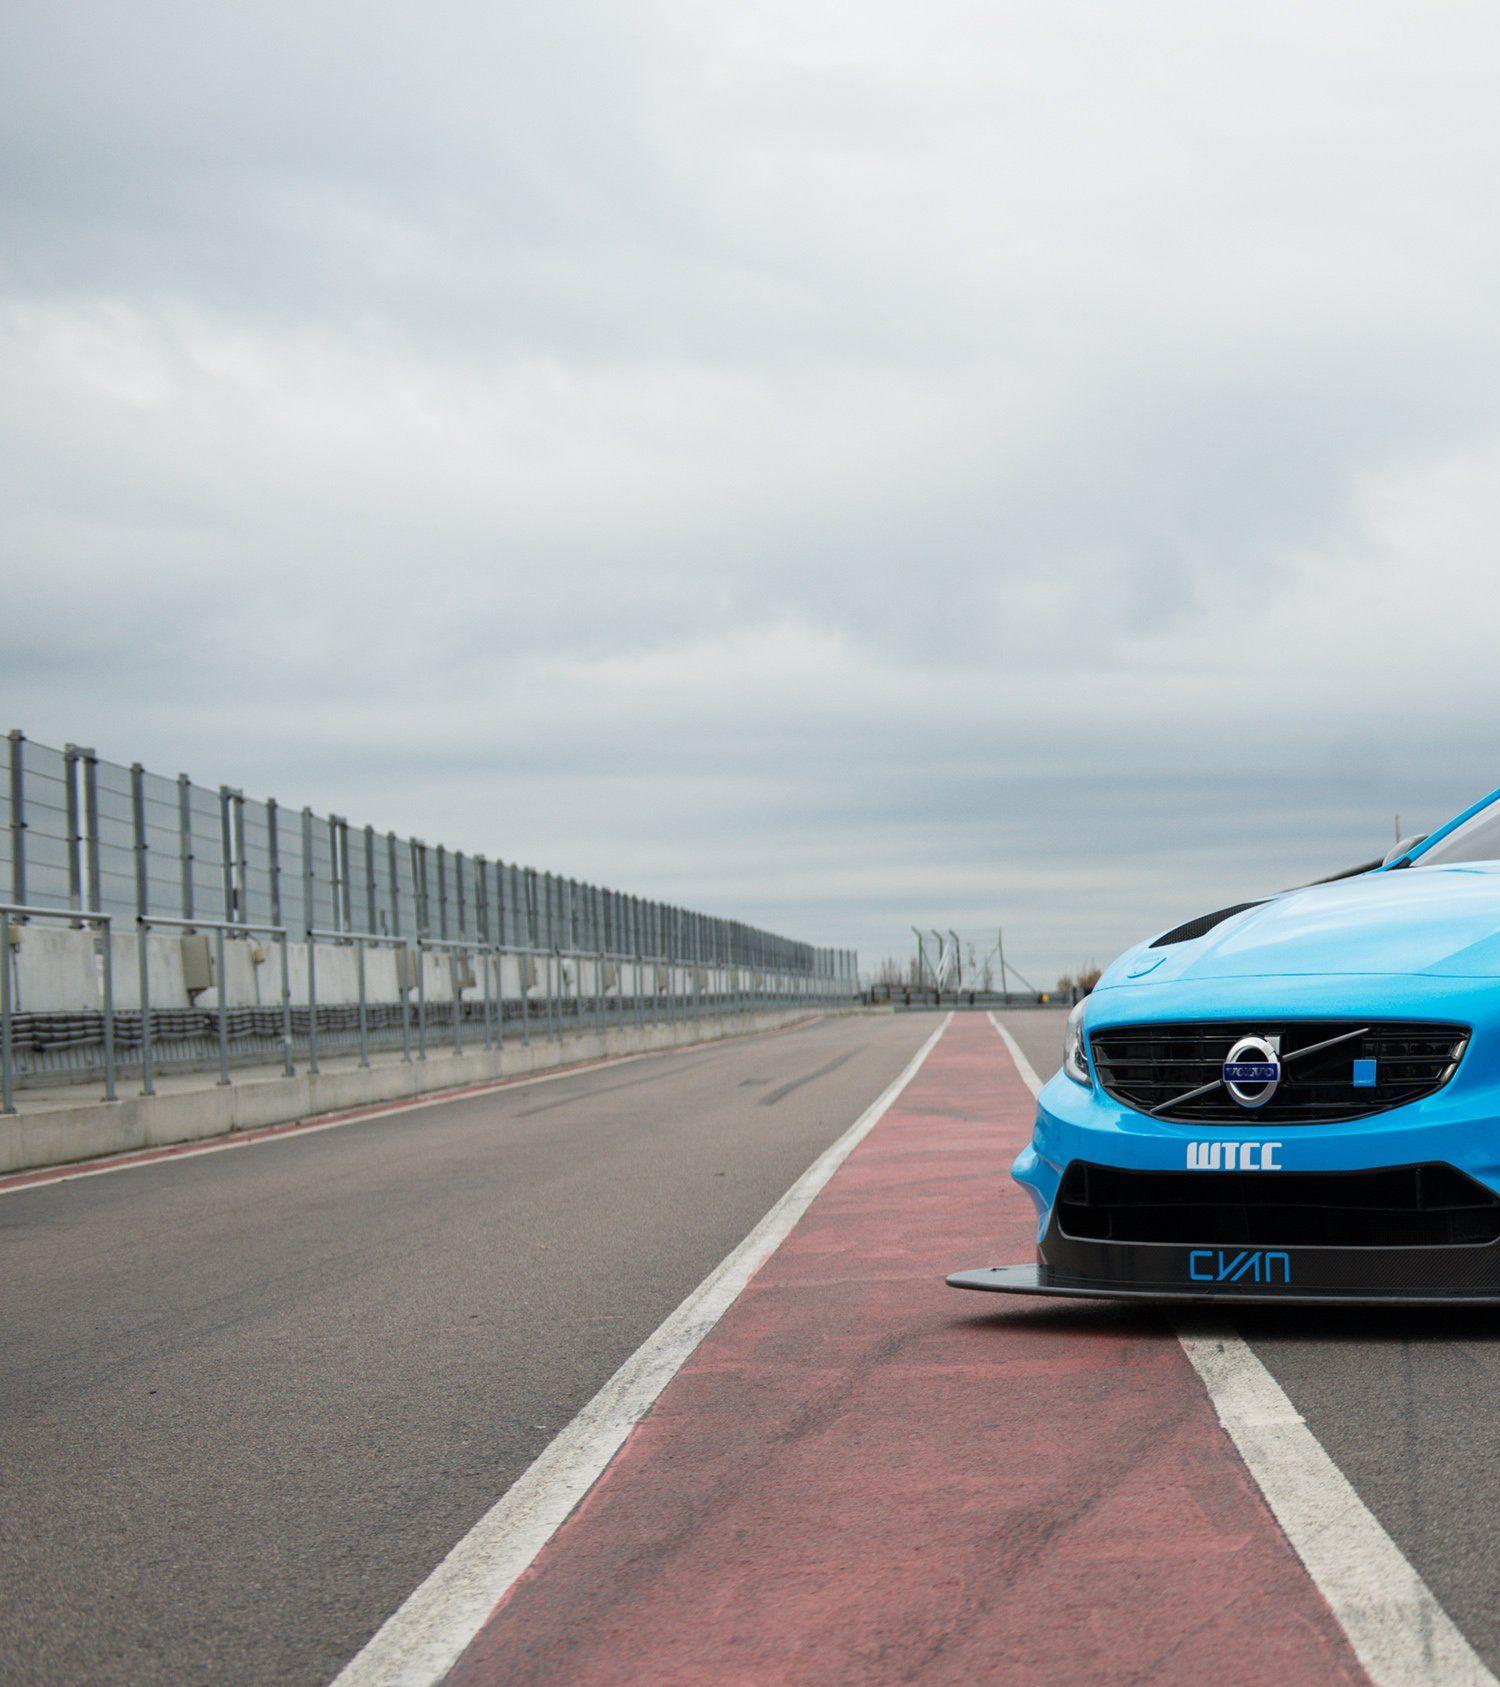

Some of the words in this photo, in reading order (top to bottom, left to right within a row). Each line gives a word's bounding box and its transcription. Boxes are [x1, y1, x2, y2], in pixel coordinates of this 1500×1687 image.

[1226, 1067, 1274, 1077] VOLVO
[1187, 1142, 1282, 1170] WTCC
[1189, 1250, 1290, 1283] CYAN
